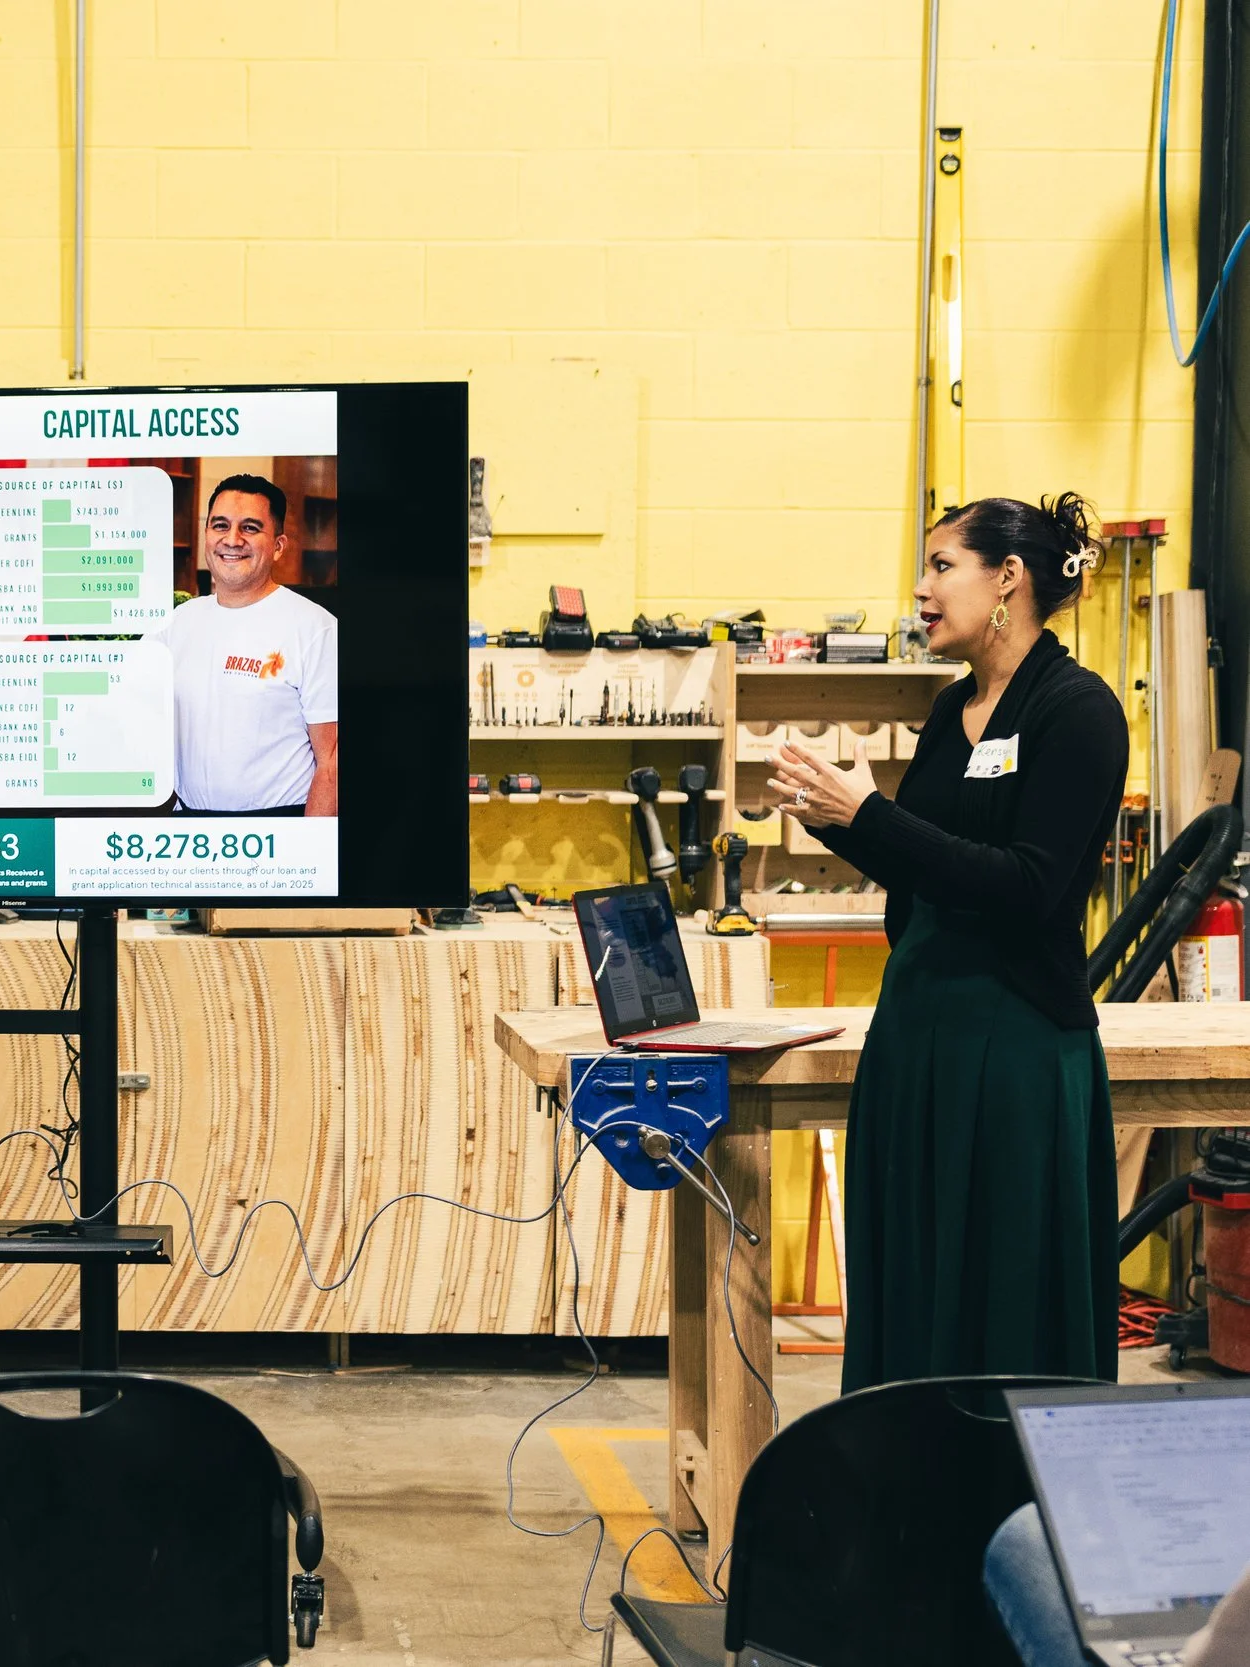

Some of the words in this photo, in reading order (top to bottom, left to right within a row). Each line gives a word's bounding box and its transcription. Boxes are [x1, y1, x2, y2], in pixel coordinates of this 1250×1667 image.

[44, 409, 141, 438] CAPITAL
[148, 407, 239, 437] ACCESS
[42, 481, 53, 490] OF
[59, 480, 101, 490] CAPITAL
[4, 534, 37, 542] GRANTS
[0, 654, 37, 663] SOURCE
[43, 654, 54, 663] OF
[60, 654, 102, 663] CAPITAL
[225, 656, 262, 673] BRAZAS
[110, 675, 120, 683] 53
[65, 703, 74, 712] 12
[0, 753, 14, 762] SBA
[67, 753, 76, 761] 12
[6, 779, 38, 788] GRANTS
[142, 778, 152, 787] 90
[106, 831, 274, 862] $8,278,801
[79, 867, 110, 877] capital
[112, 867, 156, 875] accessed
[158, 867, 170, 876] by
[189, 867, 220, 875] clients
[277, 866, 297, 875] loan
[299, 867, 317, 875] and
[71, 882, 95, 891] grant
[97, 881, 148, 891] application
[151, 881, 192, 889] technical
[259, 880, 269, 889] of
[290, 880, 314, 889] 2025
